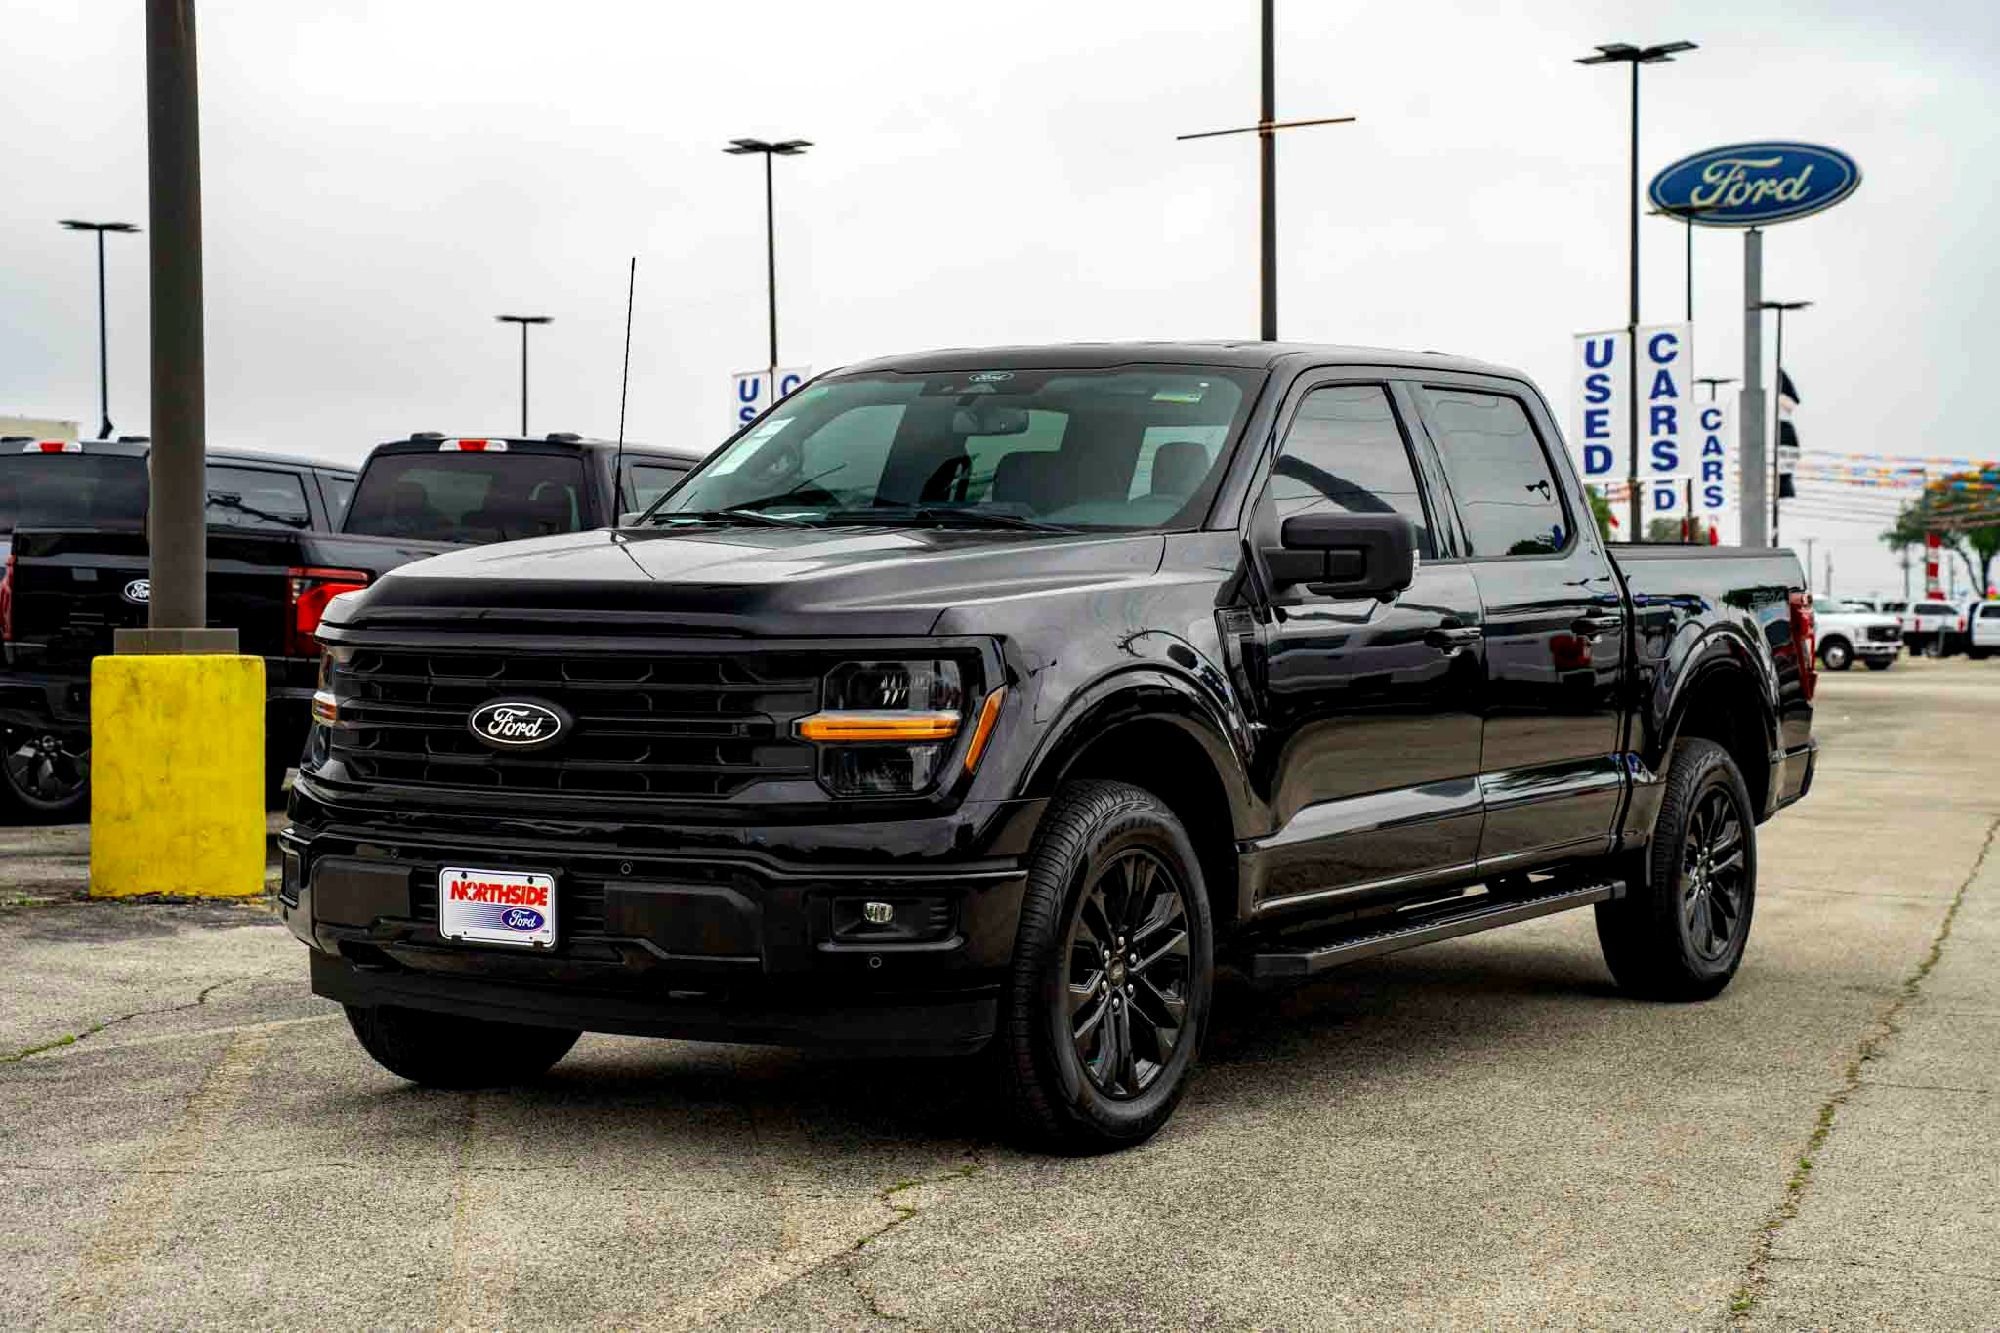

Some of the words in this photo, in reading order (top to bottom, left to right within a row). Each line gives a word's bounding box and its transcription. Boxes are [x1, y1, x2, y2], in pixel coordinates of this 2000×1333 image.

[1690, 156, 1813, 208] Ford
[739, 378, 760, 424] US
[1583, 338, 1615, 476] USED
[1647, 332, 1679, 473] CARS
[1700, 408, 1725, 509] CARS
[487, 707, 544, 738] Ford
[450, 880, 548, 906] NORTHSIDE
[508, 909, 536, 928] Ford
